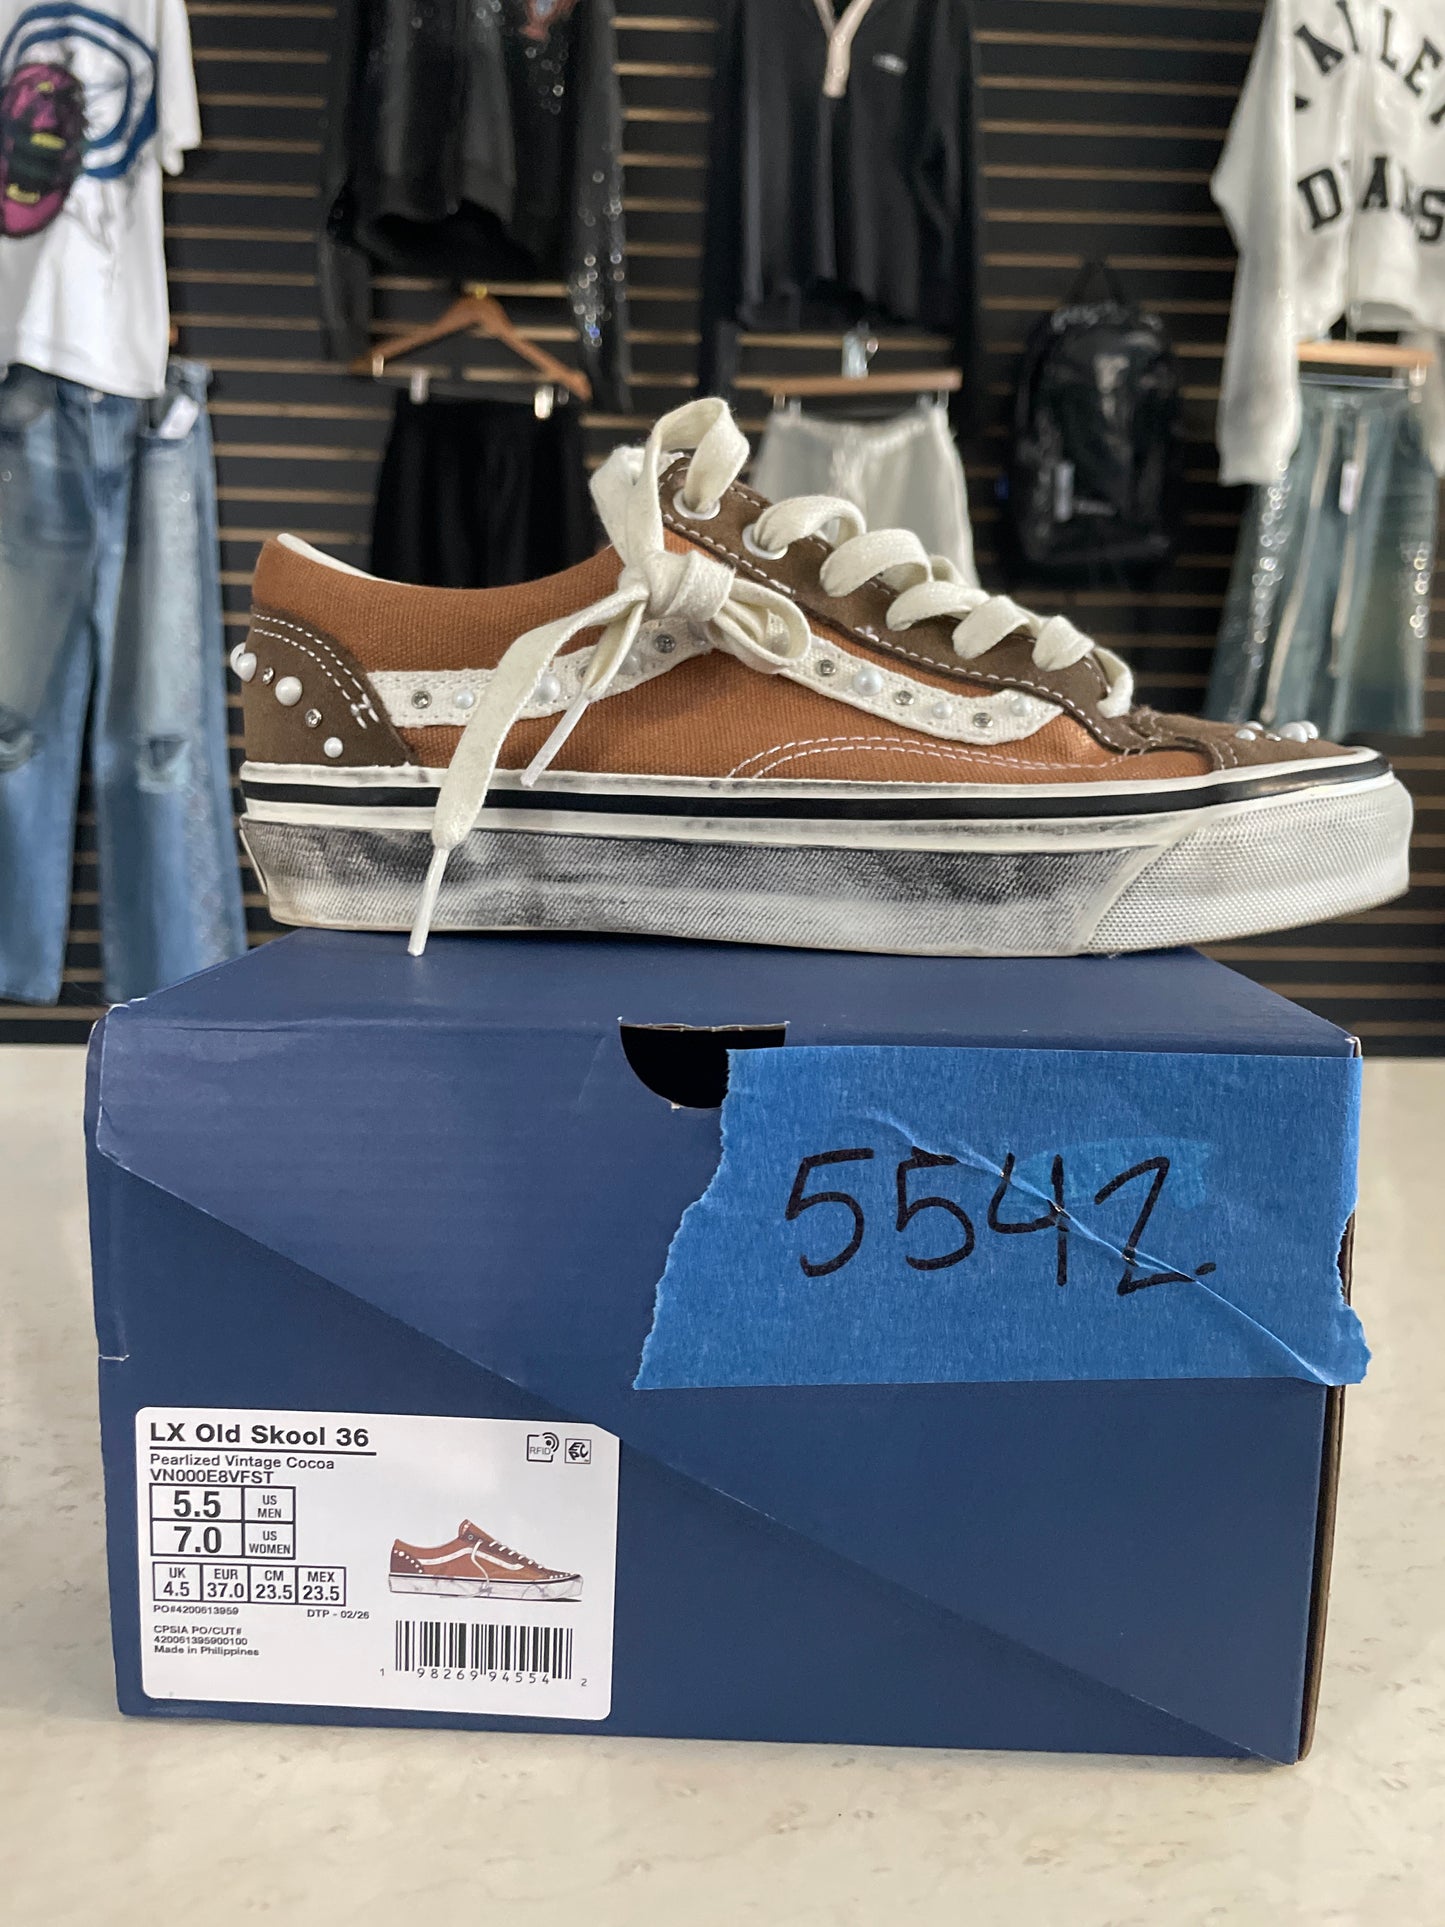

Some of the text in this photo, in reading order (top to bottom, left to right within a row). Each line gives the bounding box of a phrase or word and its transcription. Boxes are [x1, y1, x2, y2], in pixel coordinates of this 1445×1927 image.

[150, 1422, 370, 1447] LX Old Skool 36
[150, 1453, 335, 1470] Pearlized Vintage Cocoa
[151, 1468, 275, 1484] VN000E8VFST
[173, 1490, 222, 1518] 5.5
[262, 1494, 278, 1506] US
[257, 1507, 282, 1519] MEN
[173, 1525, 222, 1553] 7.0
[262, 1530, 278, 1542] US
[248, 1543, 291, 1555] WOMEN
[168, 1567, 186, 1579] UK
[213, 1568, 239, 1580] EUR
[264, 1570, 284, 1582] CM
[307, 1571, 335, 1583] MEX
[163, 1581, 190, 1597] 4.5
[207, 1582, 245, 1598] 37.0
[255, 1584, 293, 1600] 23.5
[302, 1585, 340, 1601] 23.5
[306, 1608, 330, 1618] DTP
[340, 1610, 370, 1619] 02/26
[153, 1625, 242, 1635] CPSIA PO/CUT#
[154, 1645, 260, 1656] Made in Philippines
[417, 1667, 478, 1680] 98269
[489, 1671, 550, 1685] 94554
